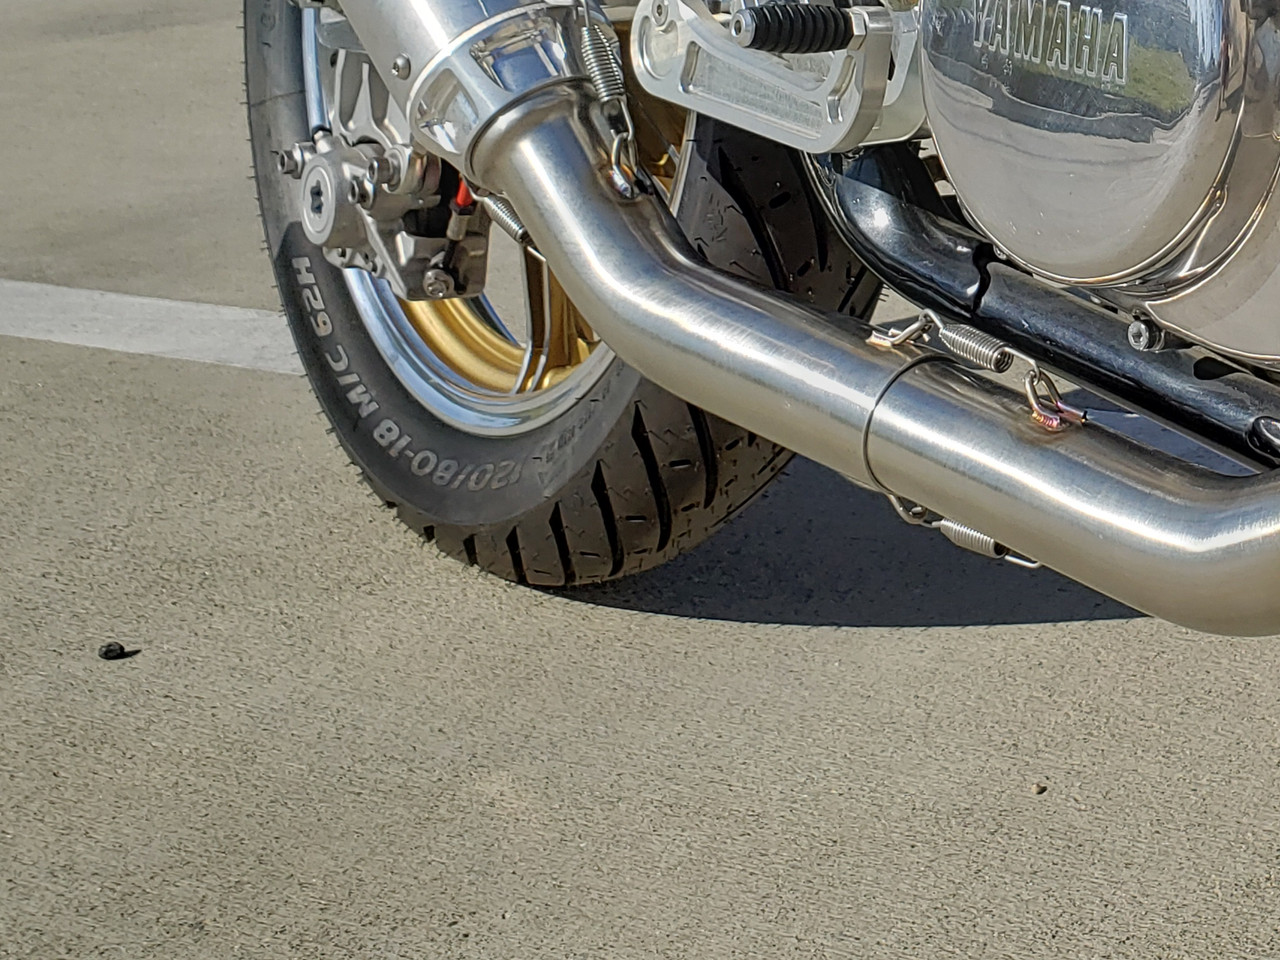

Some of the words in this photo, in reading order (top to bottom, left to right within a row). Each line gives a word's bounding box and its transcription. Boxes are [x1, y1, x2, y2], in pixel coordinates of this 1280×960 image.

[291, 256, 333, 338] 62H
[324, 344, 380, 419] M/C
[372, 417, 525, 491] 120/80-18
